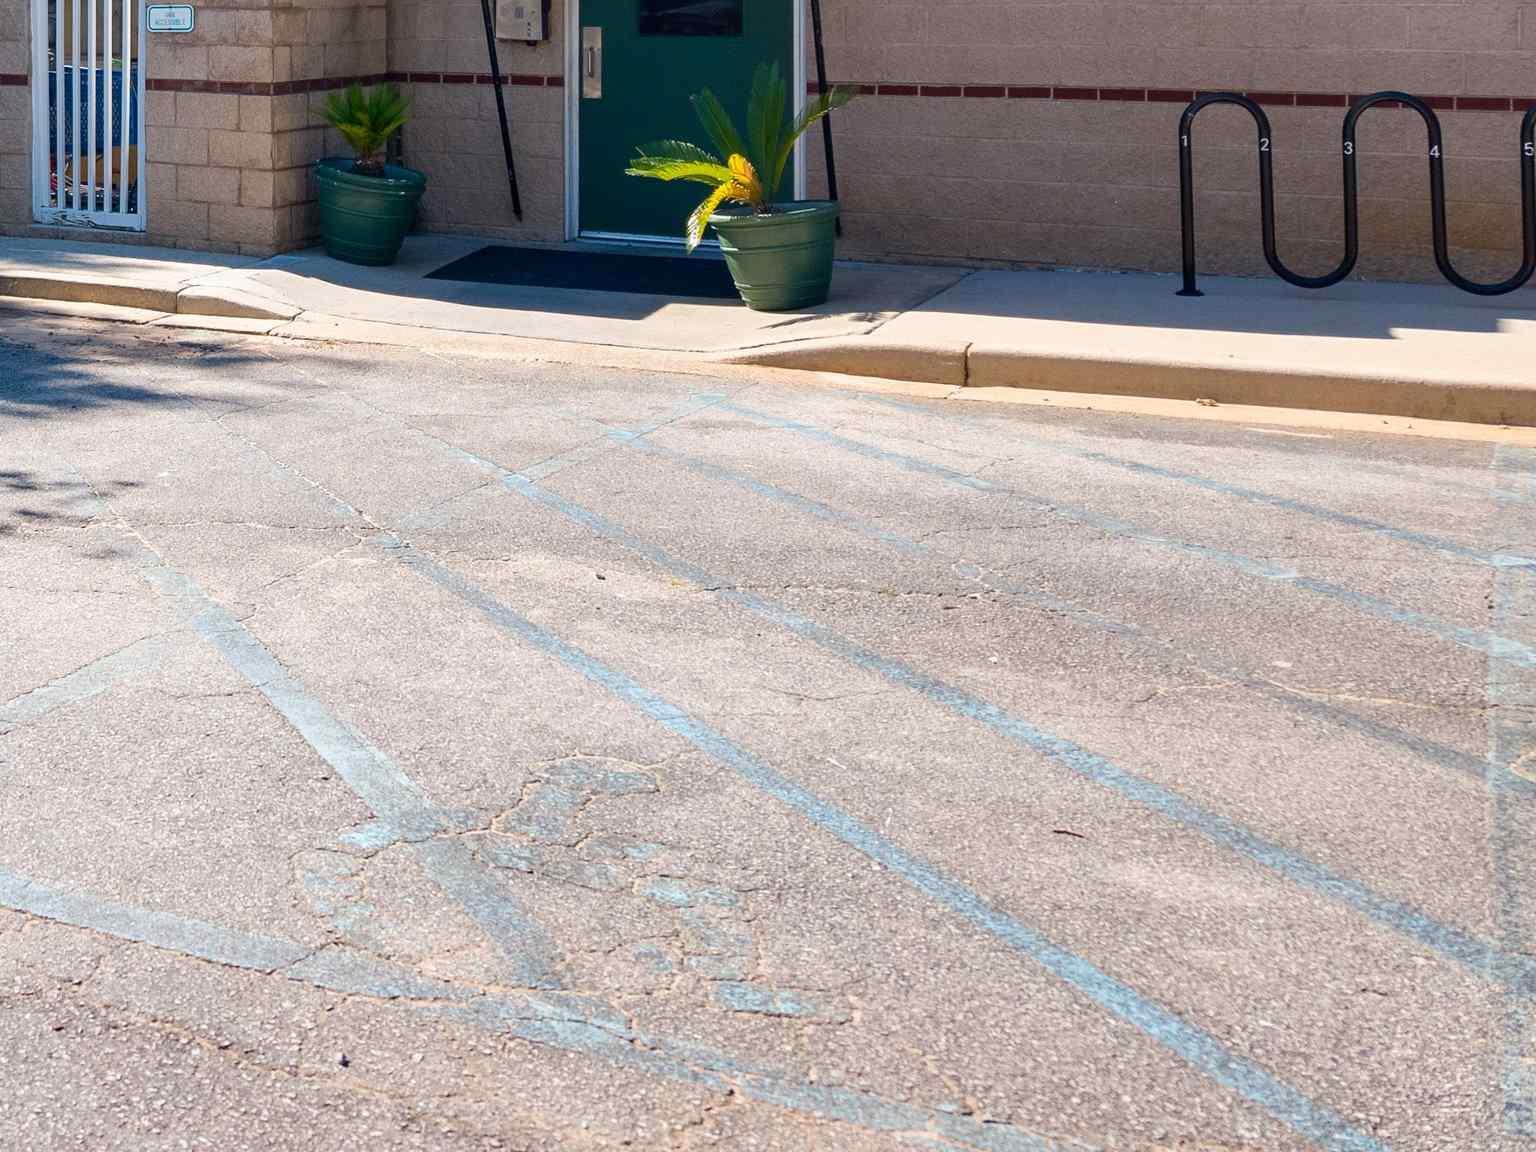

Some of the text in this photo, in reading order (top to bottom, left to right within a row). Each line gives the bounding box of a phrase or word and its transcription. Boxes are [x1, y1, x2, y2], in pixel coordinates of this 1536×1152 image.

[1181, 135, 1188, 147] 1
[1260, 137, 1270, 152] 2
[1344, 141, 1353, 155] 3
[1430, 145, 1441, 159] 4
[1524, 142, 1535, 156] 5
